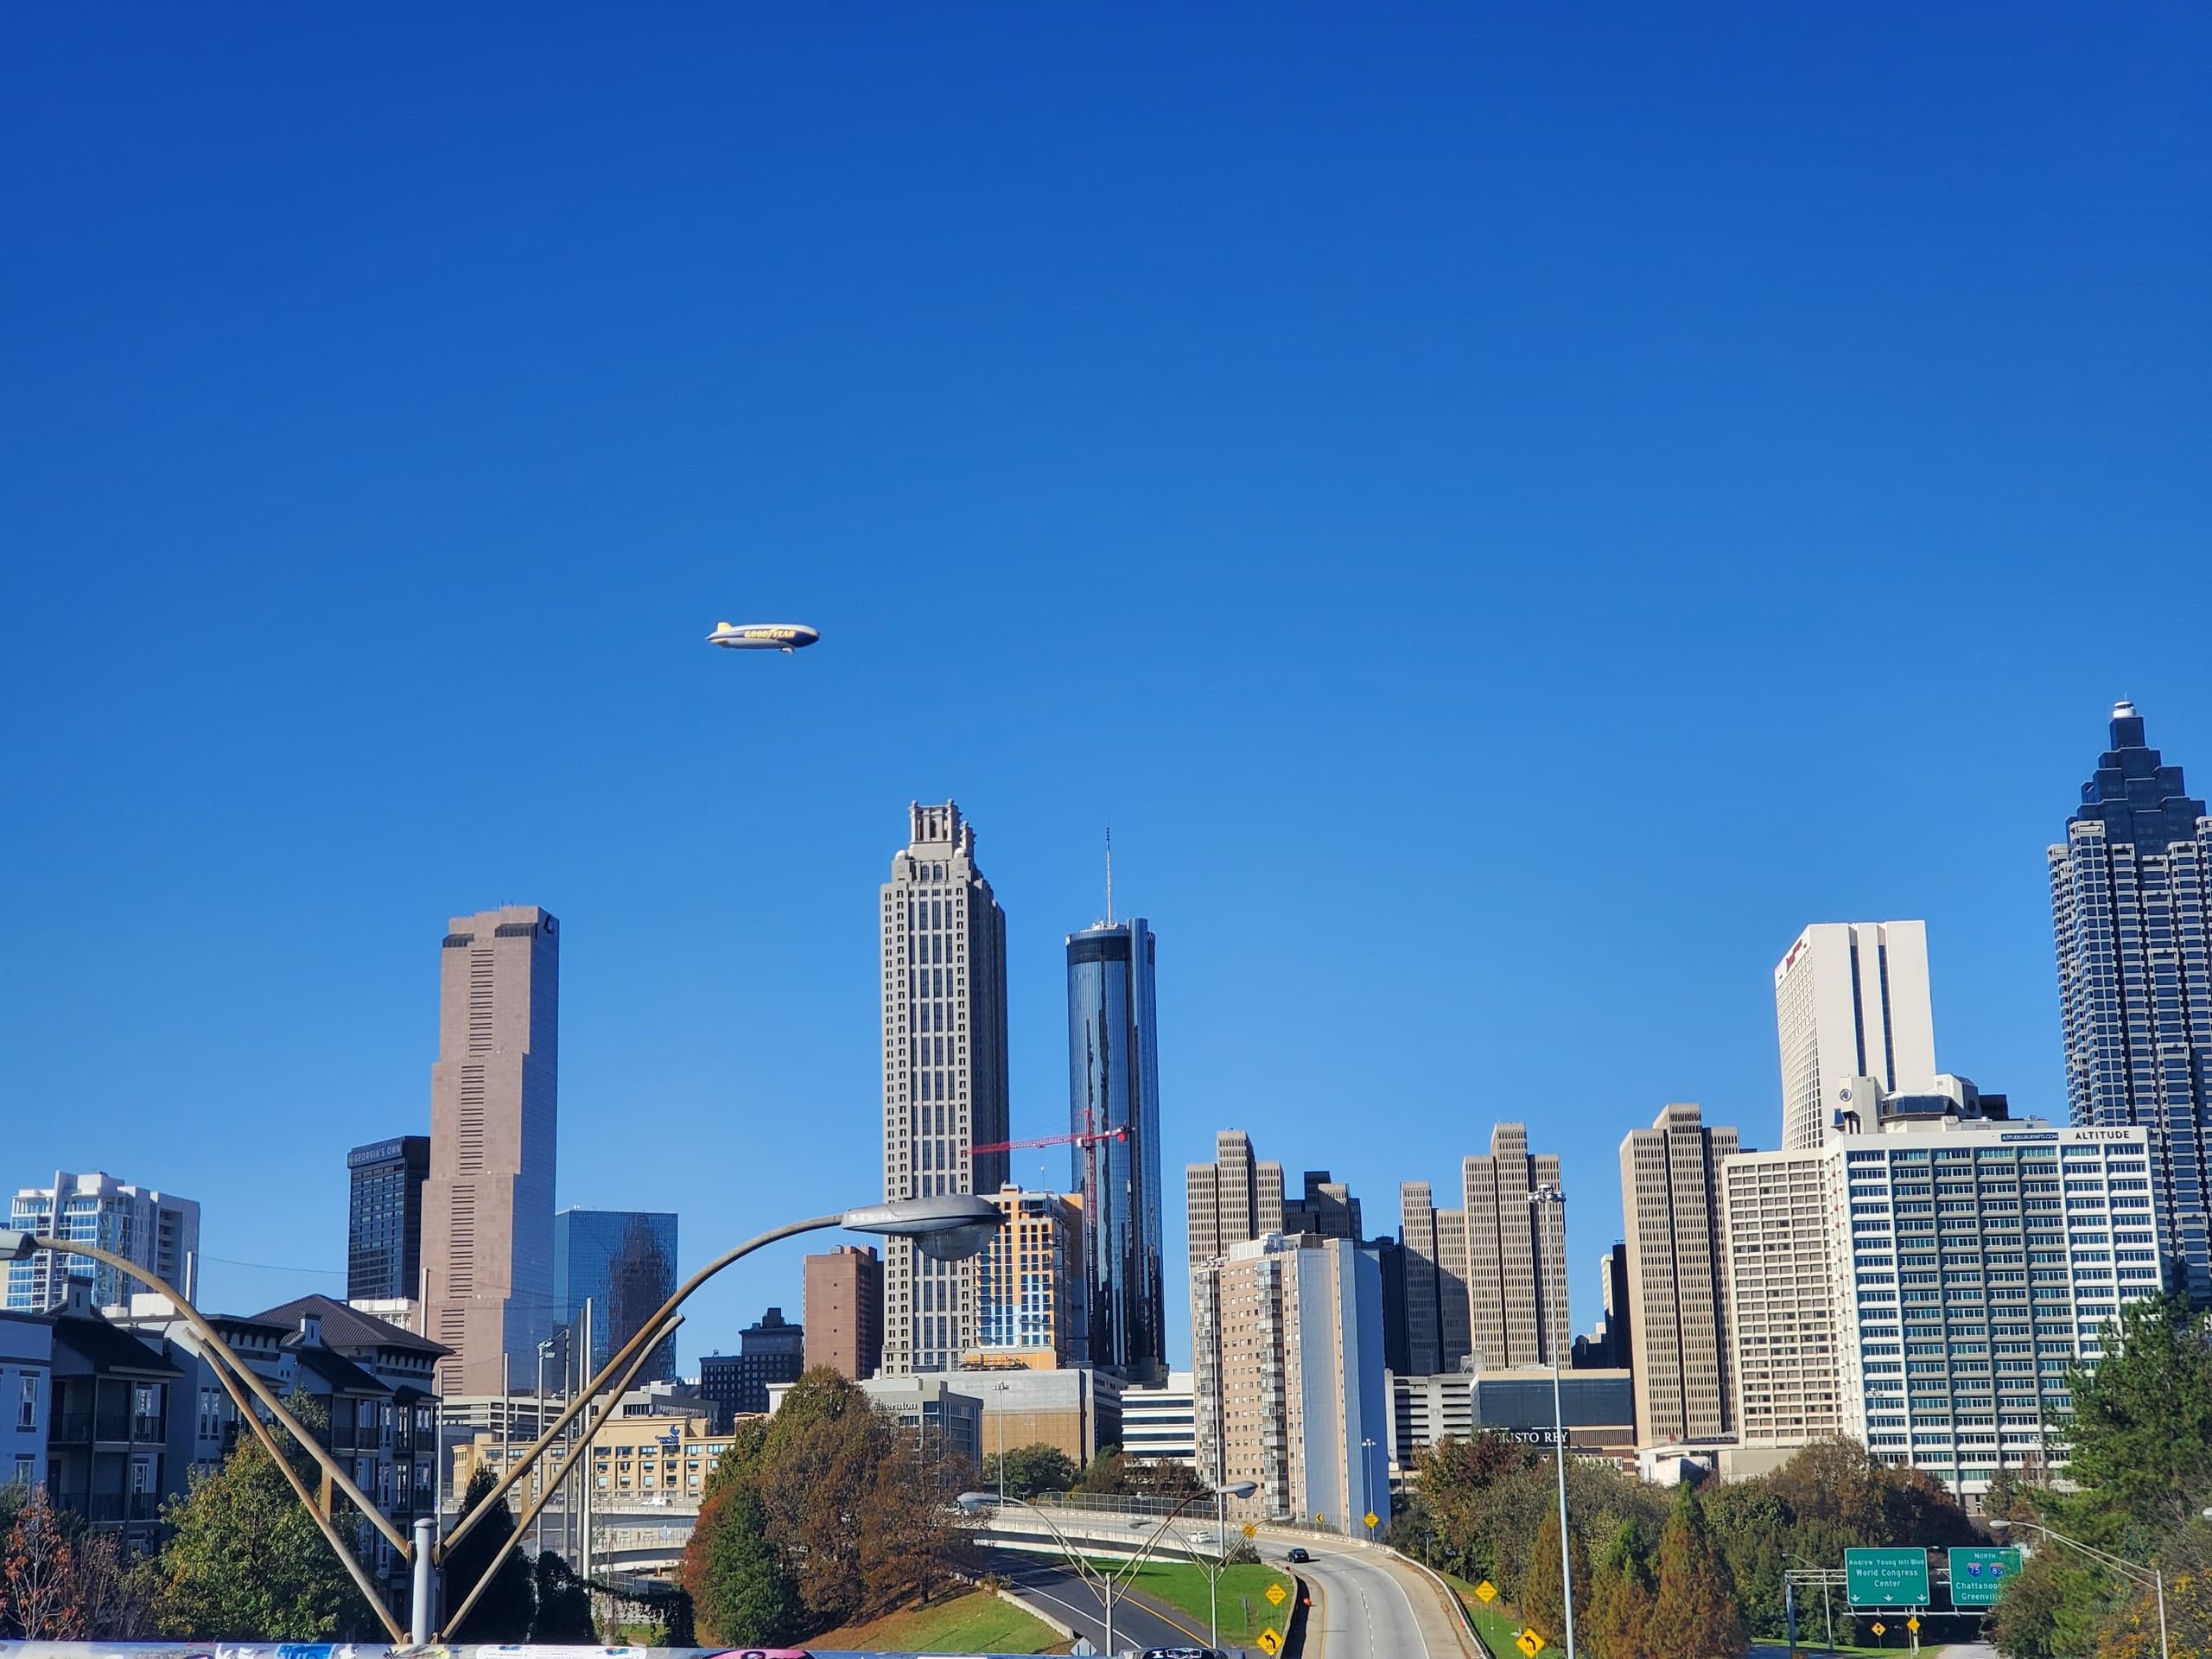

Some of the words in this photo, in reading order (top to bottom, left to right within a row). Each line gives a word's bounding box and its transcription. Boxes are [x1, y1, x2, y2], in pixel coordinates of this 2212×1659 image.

[744, 629, 796, 639] GOODYEAR
[2075, 1130, 2130, 1141] ALTITUDE
[353, 1147, 385, 1163] GEORGIA'S
[386, 1144, 401, 1155] OWN
[1881, 1569, 1918, 1579] Congress
[1969, 1567, 1980, 1575] 75
[1992, 1567, 2003, 1575] 85
[1873, 1580, 1901, 1588] Center
